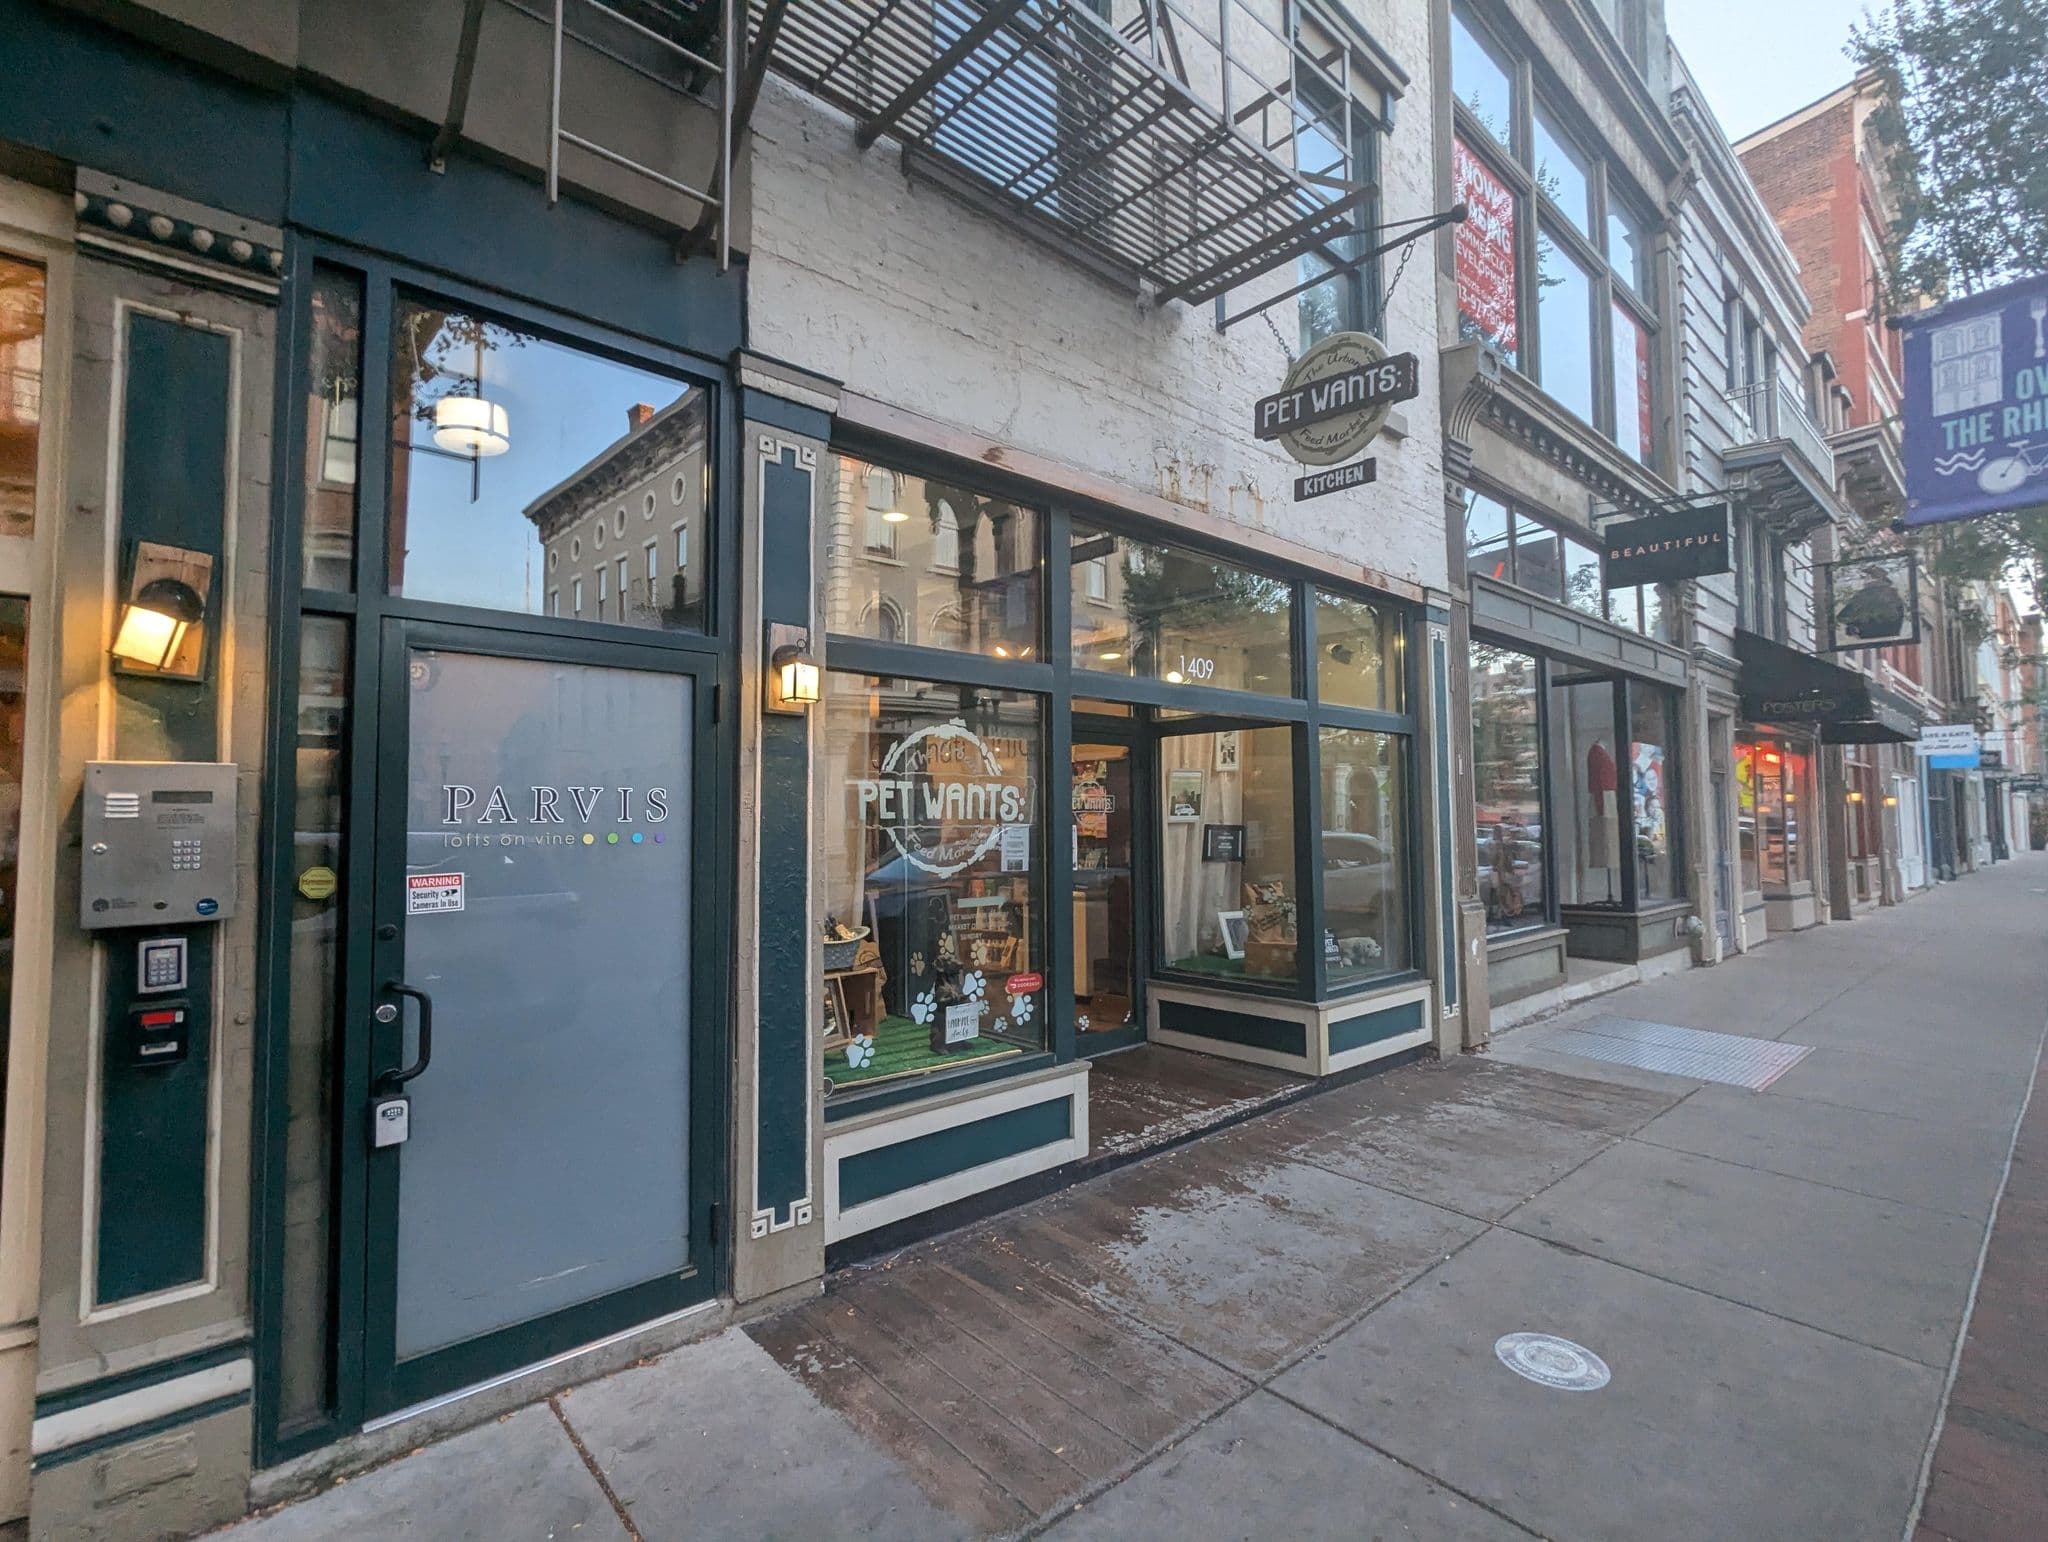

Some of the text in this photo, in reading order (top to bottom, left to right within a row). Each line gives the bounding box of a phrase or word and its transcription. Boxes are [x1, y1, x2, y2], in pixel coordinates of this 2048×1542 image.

[1461, 152, 1504, 207] NOW
[1456, 239, 1512, 298] EVELOPMENT
[1264, 392, 1304, 429] PET
[1300, 412, 1365, 445] Feed Market
[1941, 411, 1995, 450] THE
[1303, 464, 1365, 496] KITCHEN
[1610, 532, 1721, 560] BEAUTIFUL
[1180, 655, 1214, 679] 1409
[443, 785, 669, 824] PARVIS
[857, 780, 914, 820] PET
[443, 832, 576, 848] lofts on vine
[411, 876, 461, 888] WARNING
[412, 889, 440, 900] Security
[412, 901, 439, 910] Cameras
[448, 899, 459, 908] Use
